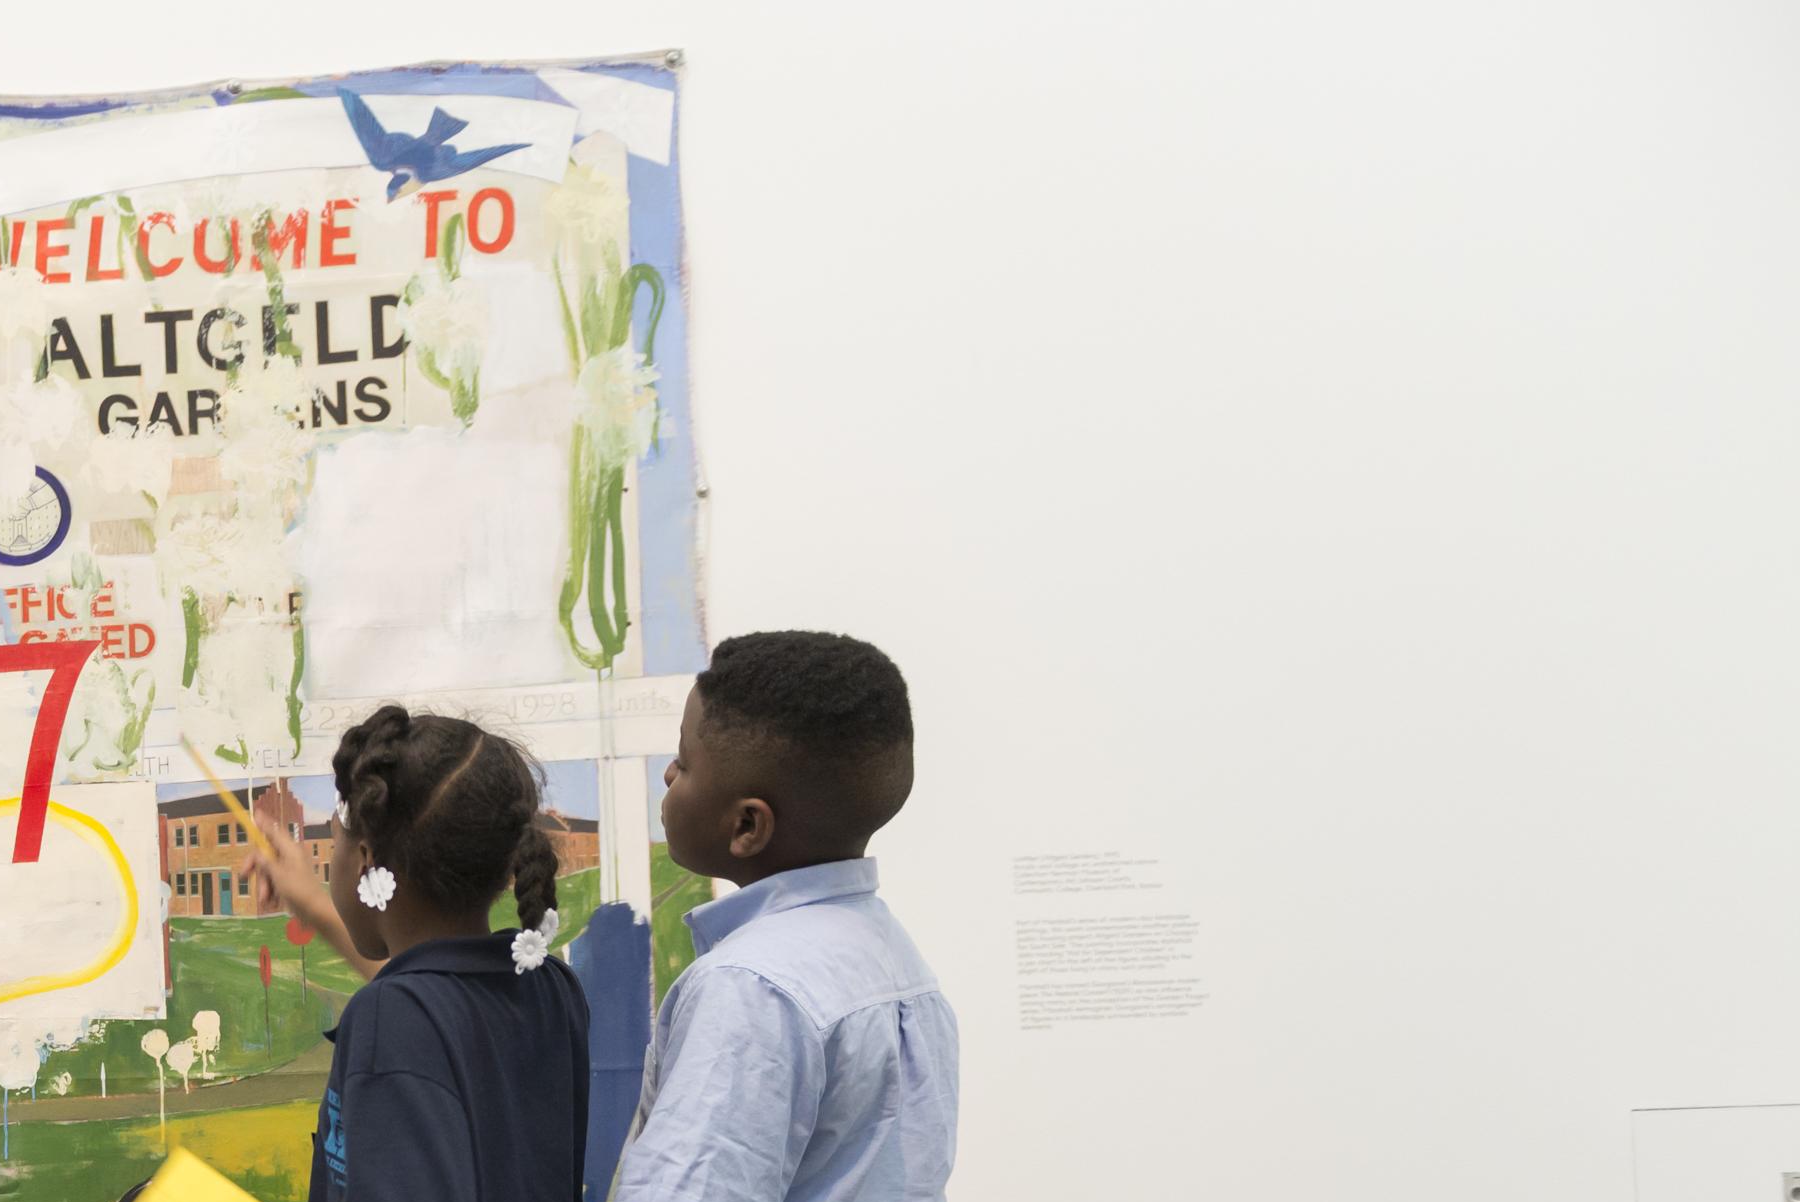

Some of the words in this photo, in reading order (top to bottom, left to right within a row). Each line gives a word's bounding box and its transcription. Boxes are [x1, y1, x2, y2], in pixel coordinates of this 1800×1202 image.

[419, 187, 516, 260] TO
[36, 294, 411, 383] ALTGELD
[98, 377, 392, 438] GARNS
